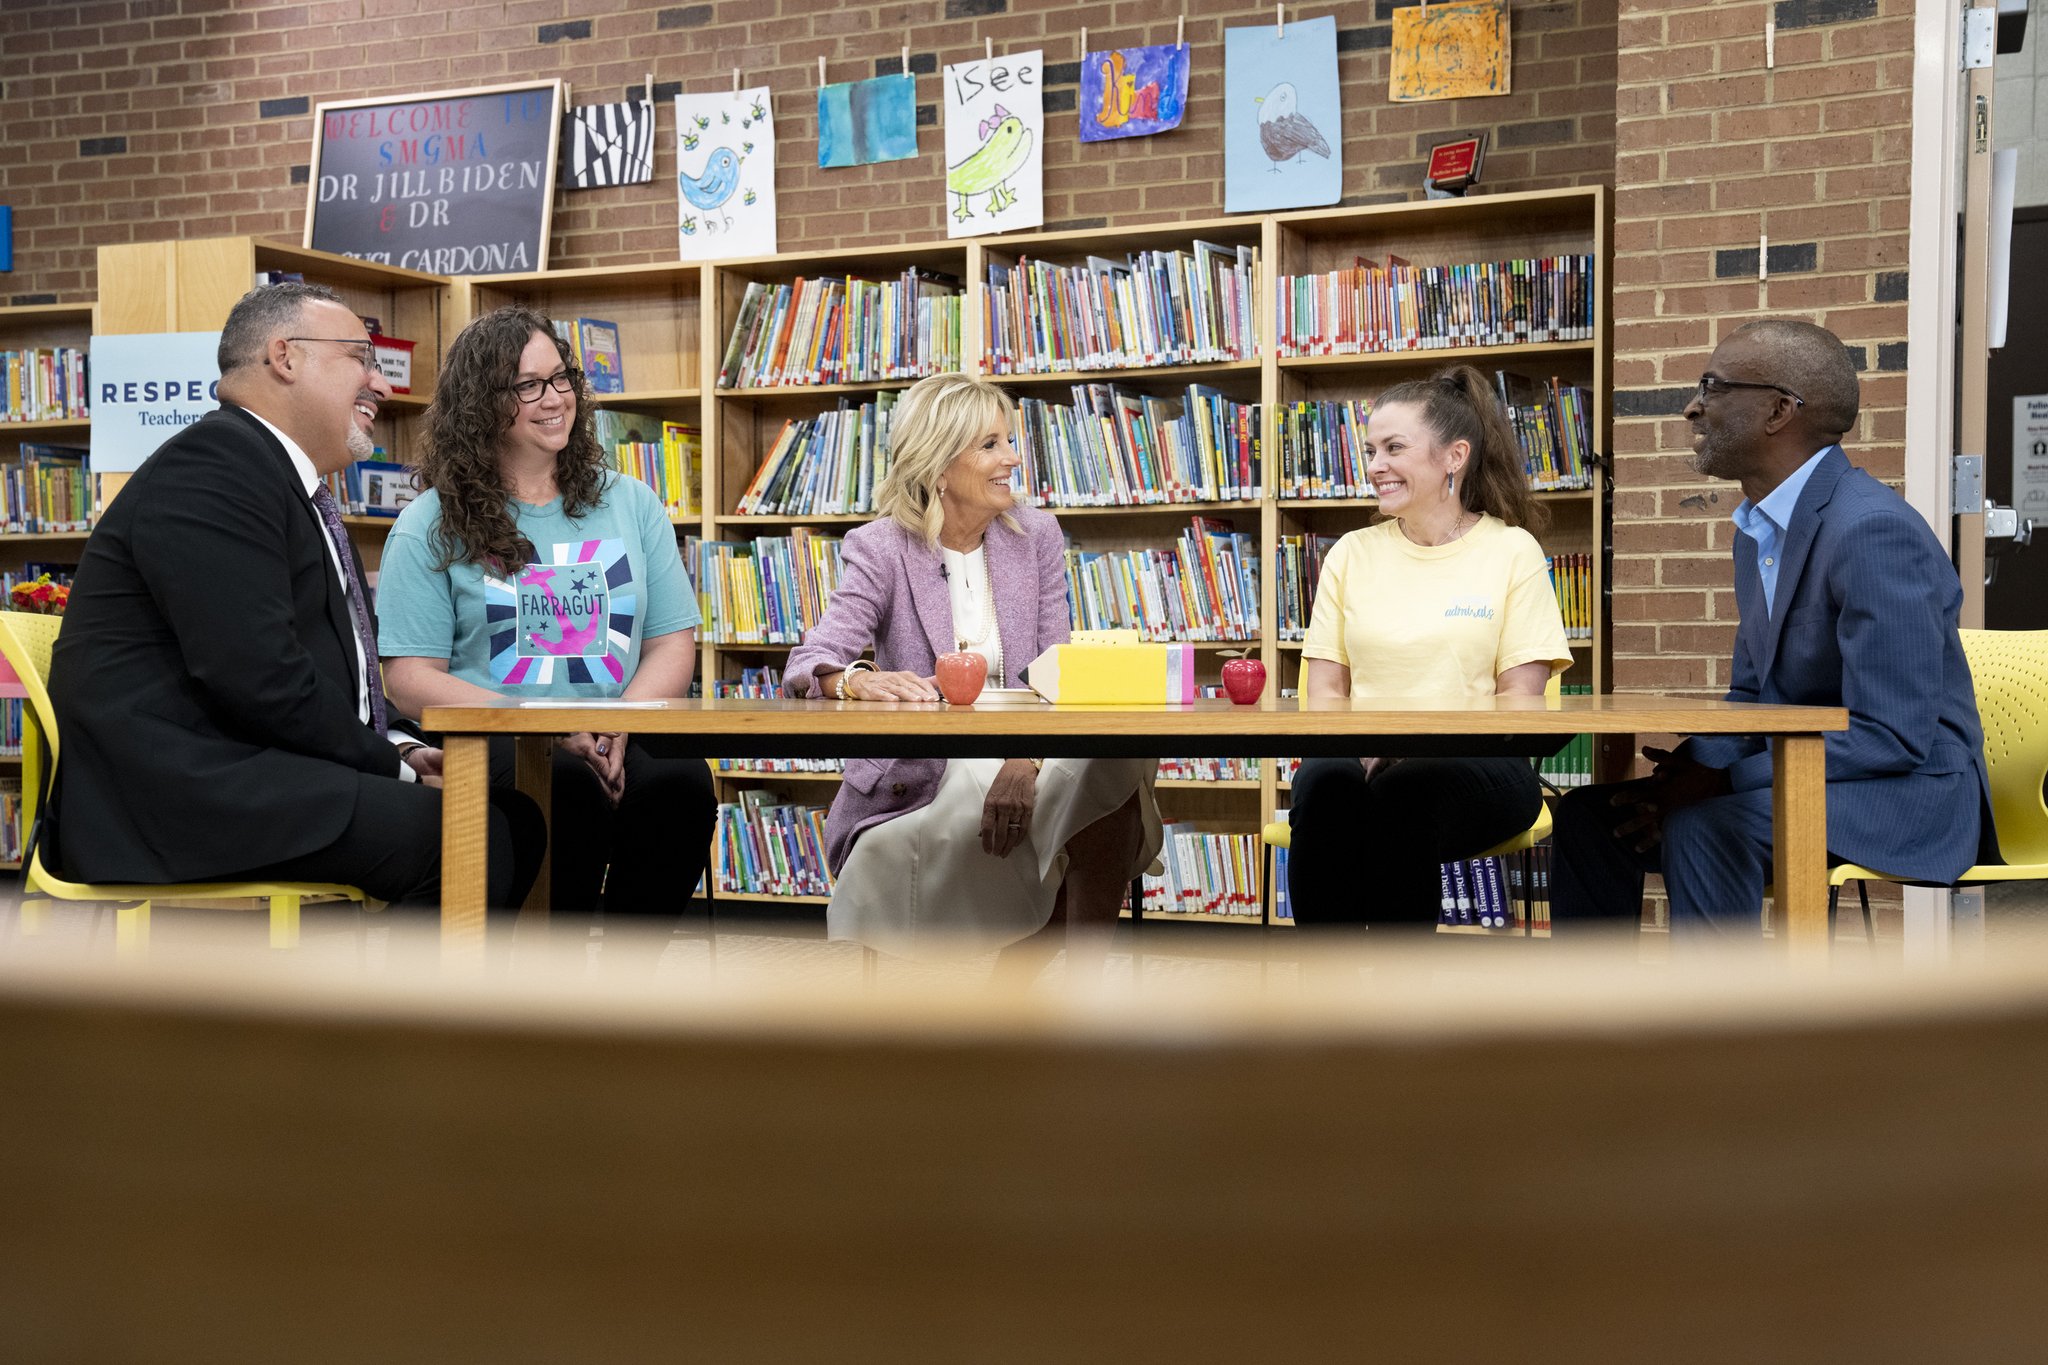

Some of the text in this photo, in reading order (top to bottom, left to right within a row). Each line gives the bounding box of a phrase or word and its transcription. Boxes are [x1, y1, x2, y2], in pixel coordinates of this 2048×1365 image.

[324, 95, 542, 140] WELCOME TO
[379, 131, 488, 168] SMGMA
[318, 160, 542, 204] DR JILL BIDEN
[408, 199, 451, 229] DR
[400, 241, 530, 275] CARDONA
[101, 380, 219, 404] RESPEC
[521, 594, 605, 616] FARRAGUT
[1441, 874, 1453, 918] Dictiory
[1456, 876, 1468, 919] Dictiry
[1475, 868, 1488, 913] Elementary
[1488, 868, 1501, 913] Elementary
